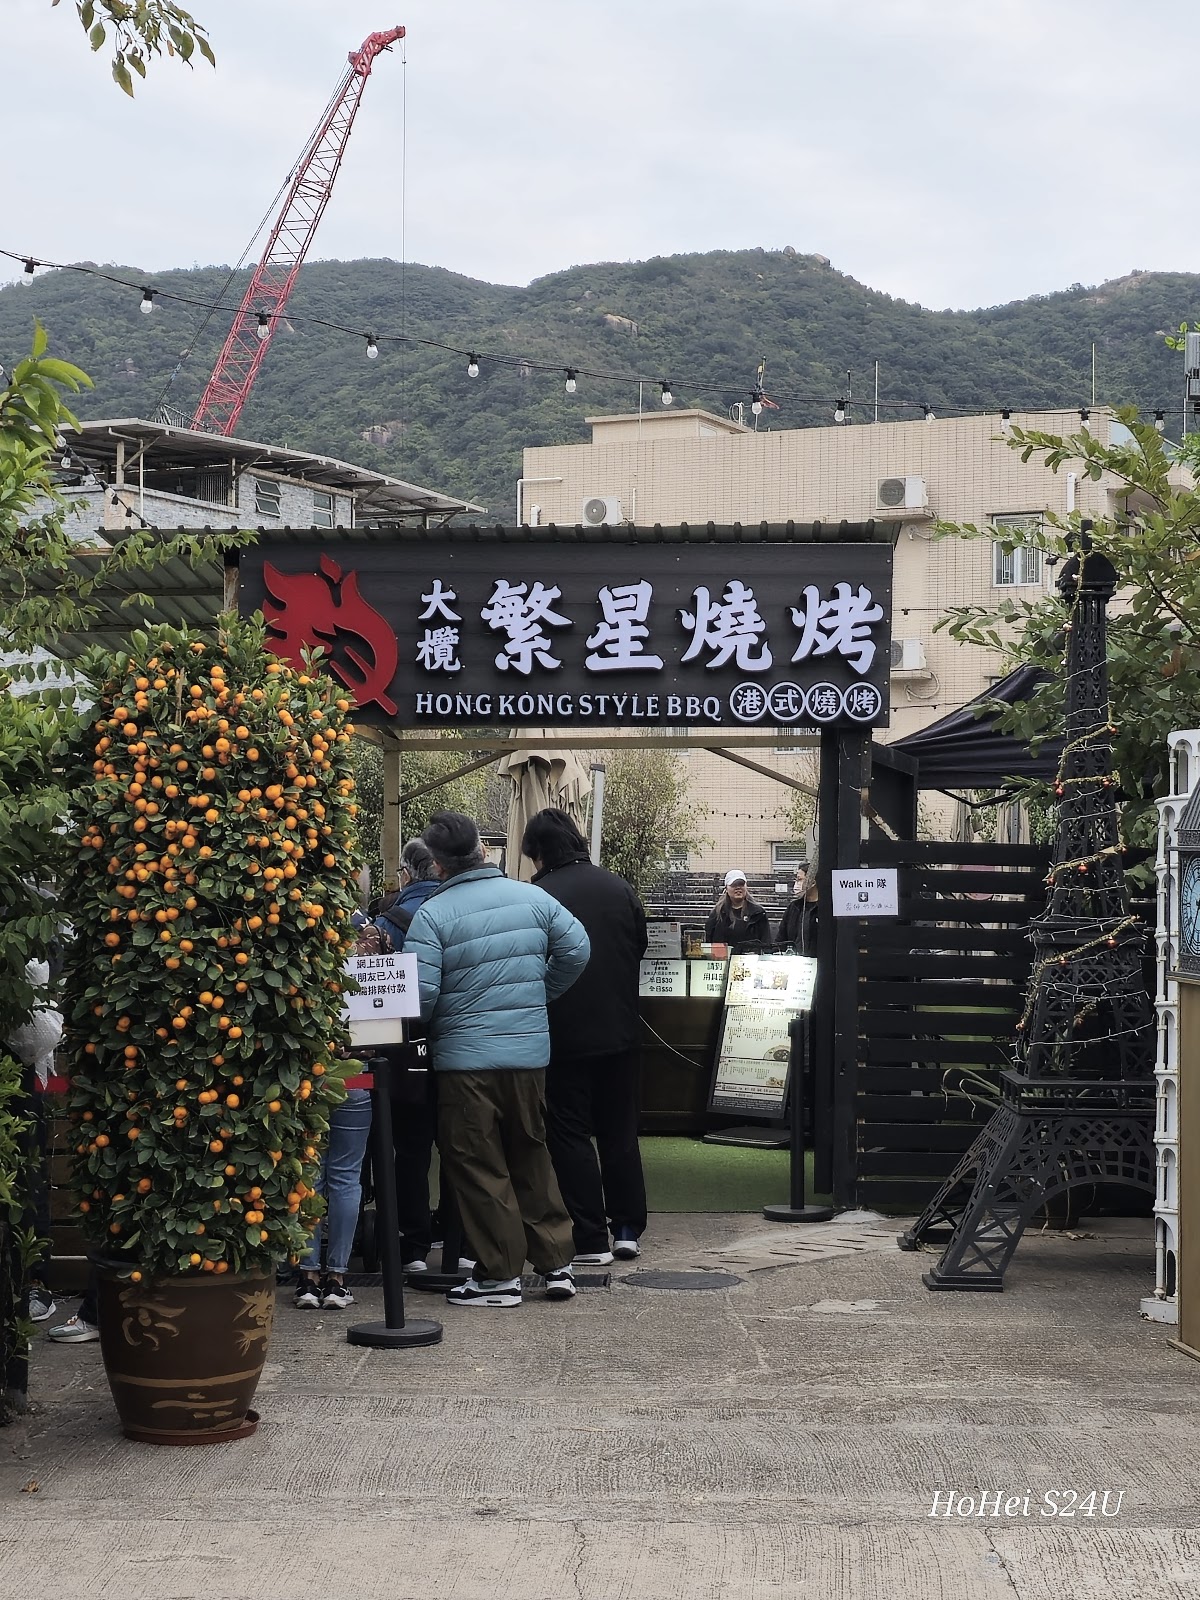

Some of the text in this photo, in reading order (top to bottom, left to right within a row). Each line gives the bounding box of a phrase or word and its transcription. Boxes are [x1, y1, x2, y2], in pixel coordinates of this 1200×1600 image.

[415, 579, 463, 672] 大欖
[480, 579, 884, 675] 繁星燒烤
[416, 693, 722, 722] HONG KONG STYLE BBQ
[731, 683, 880, 721] 港式燒烤
[839, 878, 887, 889] Walk in 隊
[356, 957, 395, 969] 網上訂位
